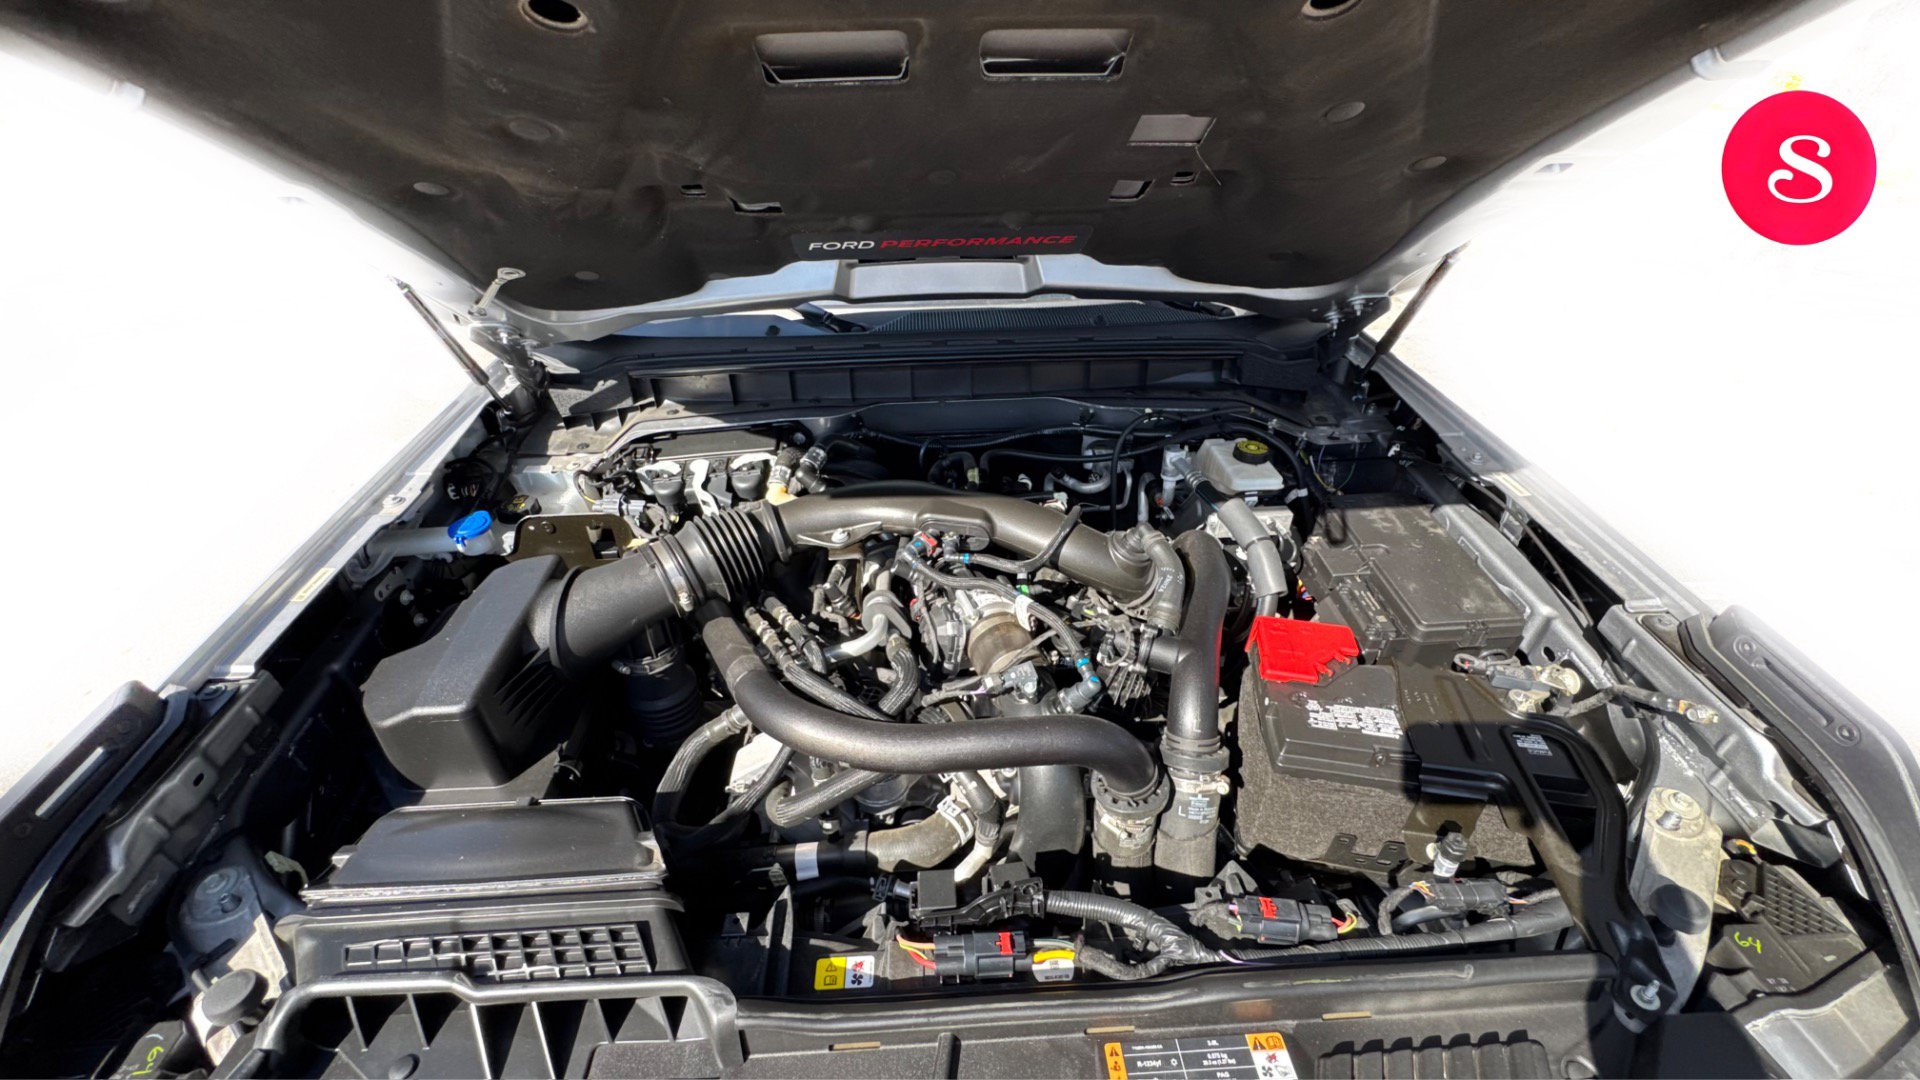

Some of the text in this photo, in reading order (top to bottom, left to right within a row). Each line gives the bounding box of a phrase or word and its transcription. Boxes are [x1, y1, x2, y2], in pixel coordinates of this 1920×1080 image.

[808, 235, 1078, 251] FORD PERFORMANCE
[1734, 931, 1762, 954] 64
